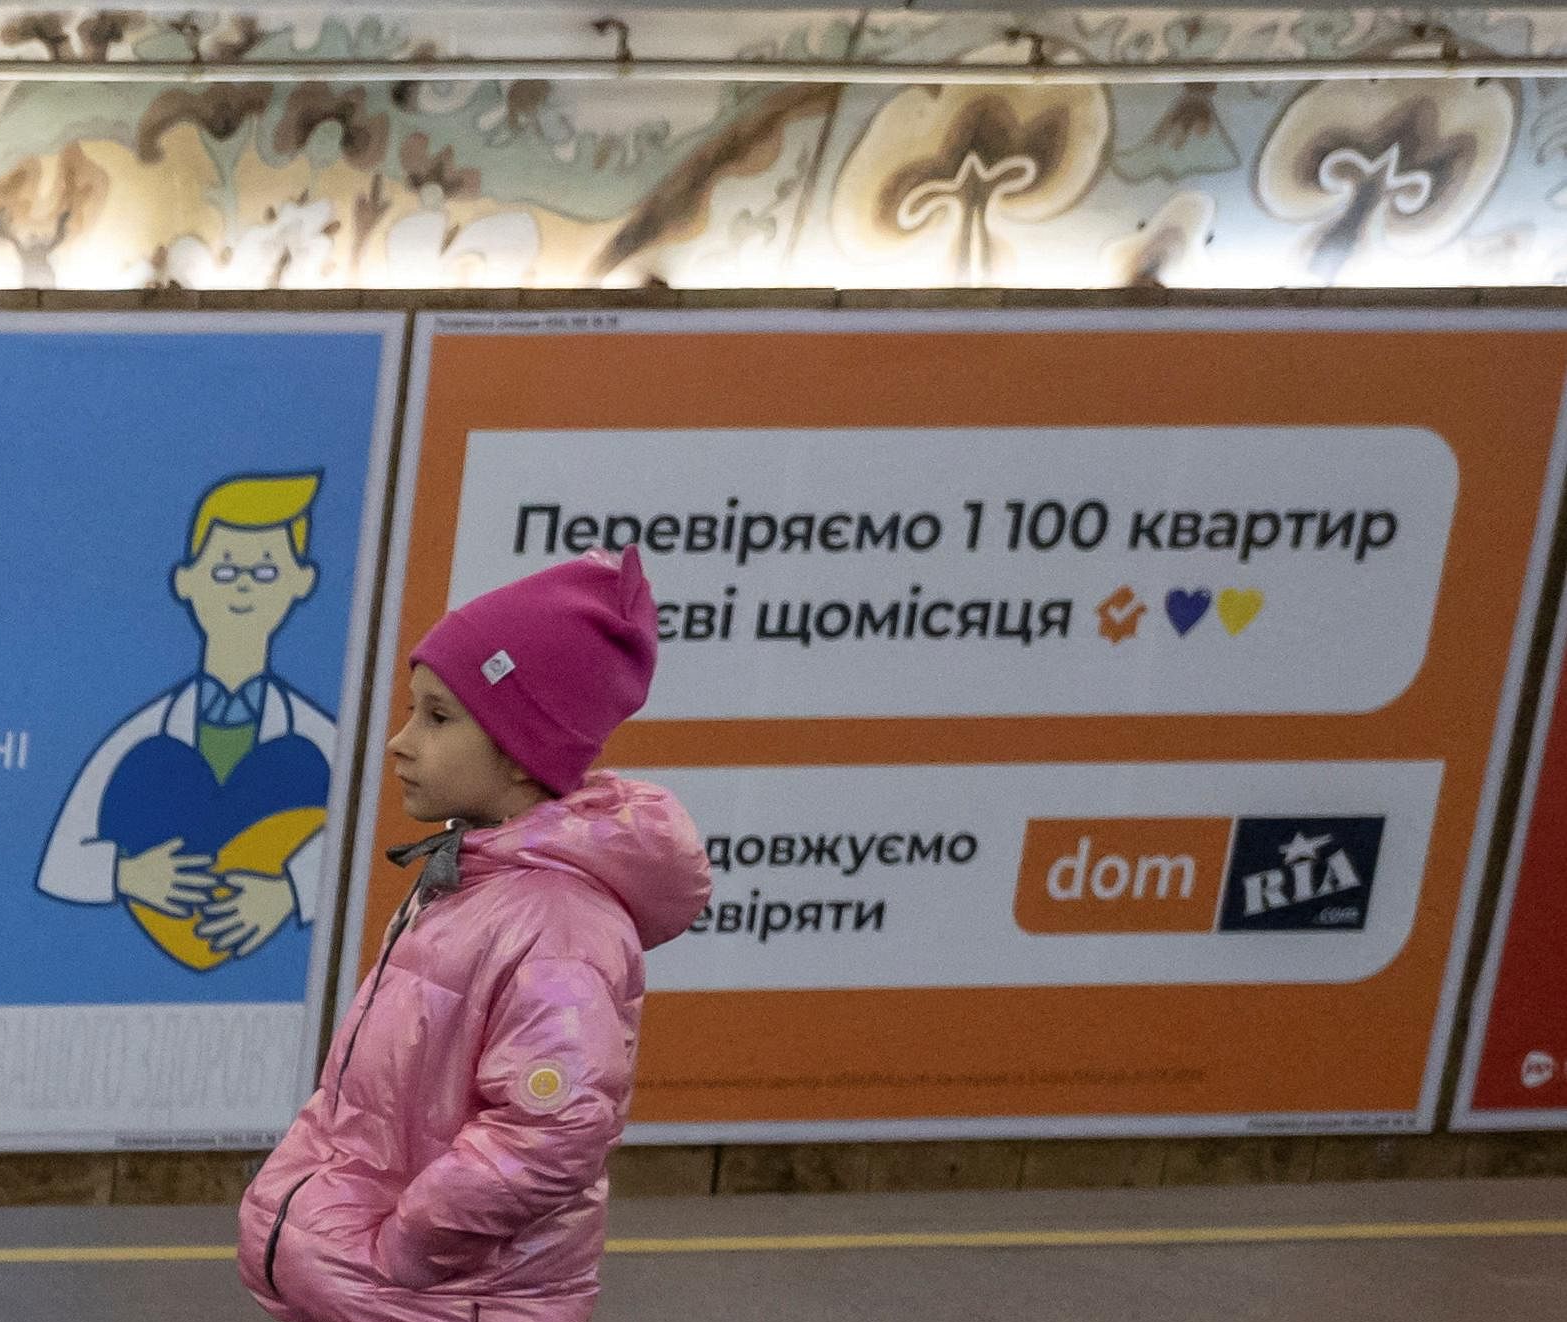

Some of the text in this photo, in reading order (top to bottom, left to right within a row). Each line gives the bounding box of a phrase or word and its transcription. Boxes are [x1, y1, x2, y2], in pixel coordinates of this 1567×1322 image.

[513, 498, 943, 566] Перевіряємо
[1128, 507, 1400, 564] квартир
[755, 583, 1073, 647] щомісяця
[1046, 836, 1363, 917] dom RIA
